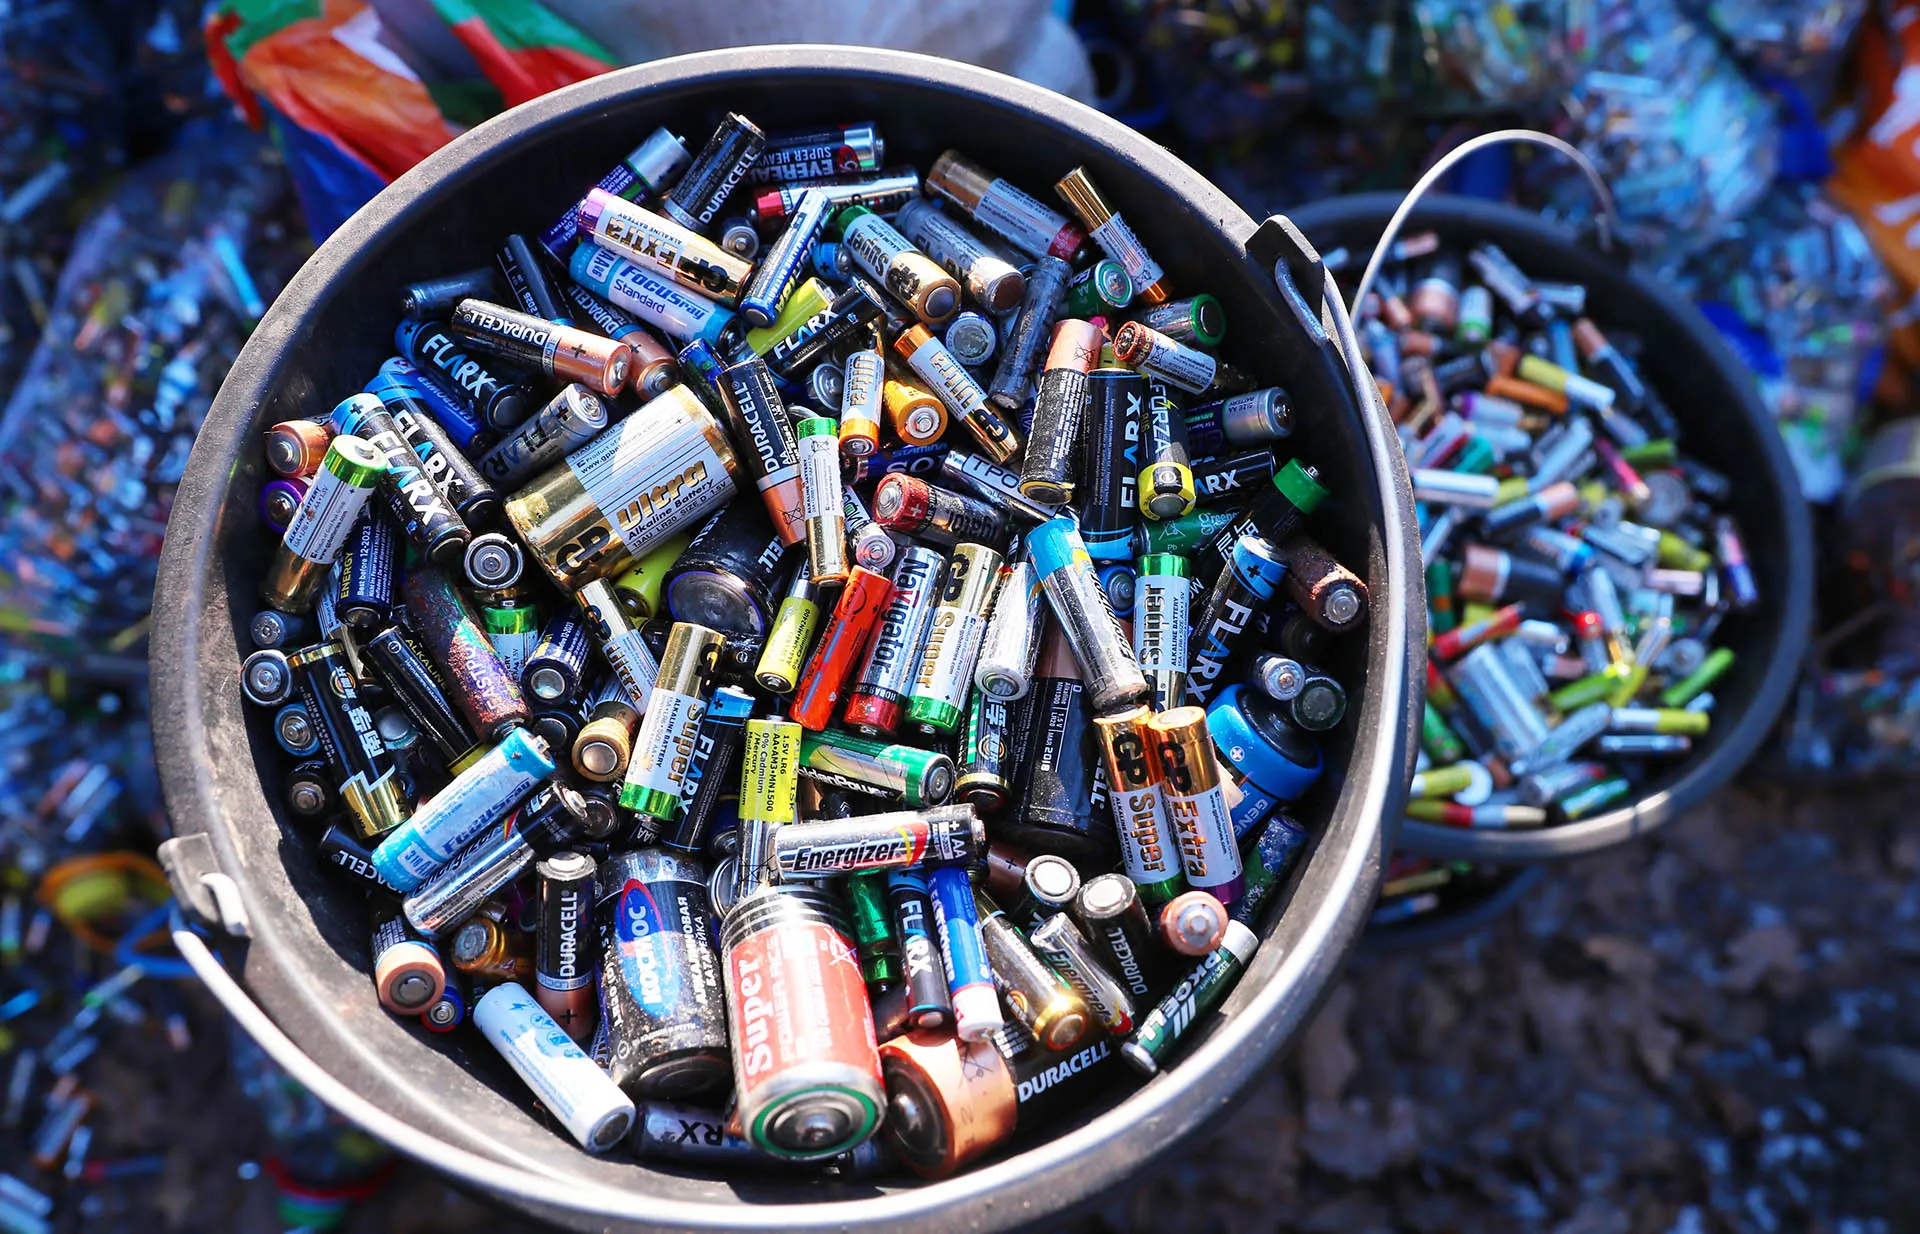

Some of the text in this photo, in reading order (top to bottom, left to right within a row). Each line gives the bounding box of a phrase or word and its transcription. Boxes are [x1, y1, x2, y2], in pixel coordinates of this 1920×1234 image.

[748, 158, 834, 182] EVEREA
[793, 145, 832, 159] SUPER
[699, 150, 761, 224] DURACELL
[604, 217, 680, 263] Extra
[850, 229, 888, 277] Super
[613, 279, 666, 314] Standard
[469, 310, 549, 347] DURACELL
[773, 306, 840, 361] FLARX
[422, 333, 497, 398] FLARX
[850, 356, 875, 406] Ultra
[930, 350, 981, 409] Ultra
[394, 410, 464, 504] FLARX
[733, 381, 780, 472] DURACELL
[368, 430, 450, 526] FLARX
[616, 460, 709, 533] Ultra
[626, 477, 715, 540] Alkaline Battery
[287, 512, 306, 542] ALKALINE
[632, 480, 727, 547] 13AU LR20 SIZE D 1.5V
[340, 551, 353, 599] ENERGY
[356, 524, 370, 596] Best before 12-2023
[556, 526, 611, 575] GP
[943, 554, 970, 602] GP
[870, 557, 930, 676] Navigator
[948, 614, 969, 675] www.gpbatteries.com
[1139, 584, 1166, 668] Super
[404, 636, 449, 690] ALKALINE
[603, 643, 647, 703] Ultra
[917, 610, 956, 690] Super
[1187, 597, 1253, 704] FLARX
[1048, 711, 1057, 727] LR20
[1052, 681, 1063, 704] MN1300
[1059, 681, 1070, 704] Alkaline
[1072, 684, 1082, 692] D
[655, 697, 680, 767] ALKALINE BATTERY
[667, 702, 706, 789] Super
[750, 732, 760, 774] /Mercury
[756, 732, 769, 793] 0% Cadmium
[779, 734, 789, 774] 1.5V LR6
[1041, 746, 1054, 772] 2018
[1111, 732, 1149, 785] GP
[676, 737, 715, 816] FLARX
[740, 731, 753, 805] Made in Belgium
[1159, 741, 1193, 792] GP
[793, 839, 903, 873] Energizer
[951, 837, 966, 858] AA
[1114, 796, 1134, 864] ALKALINE BATTERY
[1129, 792, 1168, 873] Super
[1172, 799, 1210, 877] Extra
[560, 892, 578, 977] DURACELL
[631, 904, 662, 1004] КОСМОС
[676, 895, 708, 1005] АЛКАЛИНОВАЯ
[695, 915, 717, 988] БАТАРЕЙКА
[900, 900, 933, 978] FLARX
[1109, 926, 1149, 996] DURACELL
[740, 958, 776, 1076] Super
[1136, 951, 1223, 1042] PKCELL
[1017, 1040, 1112, 1103] DURACELL
